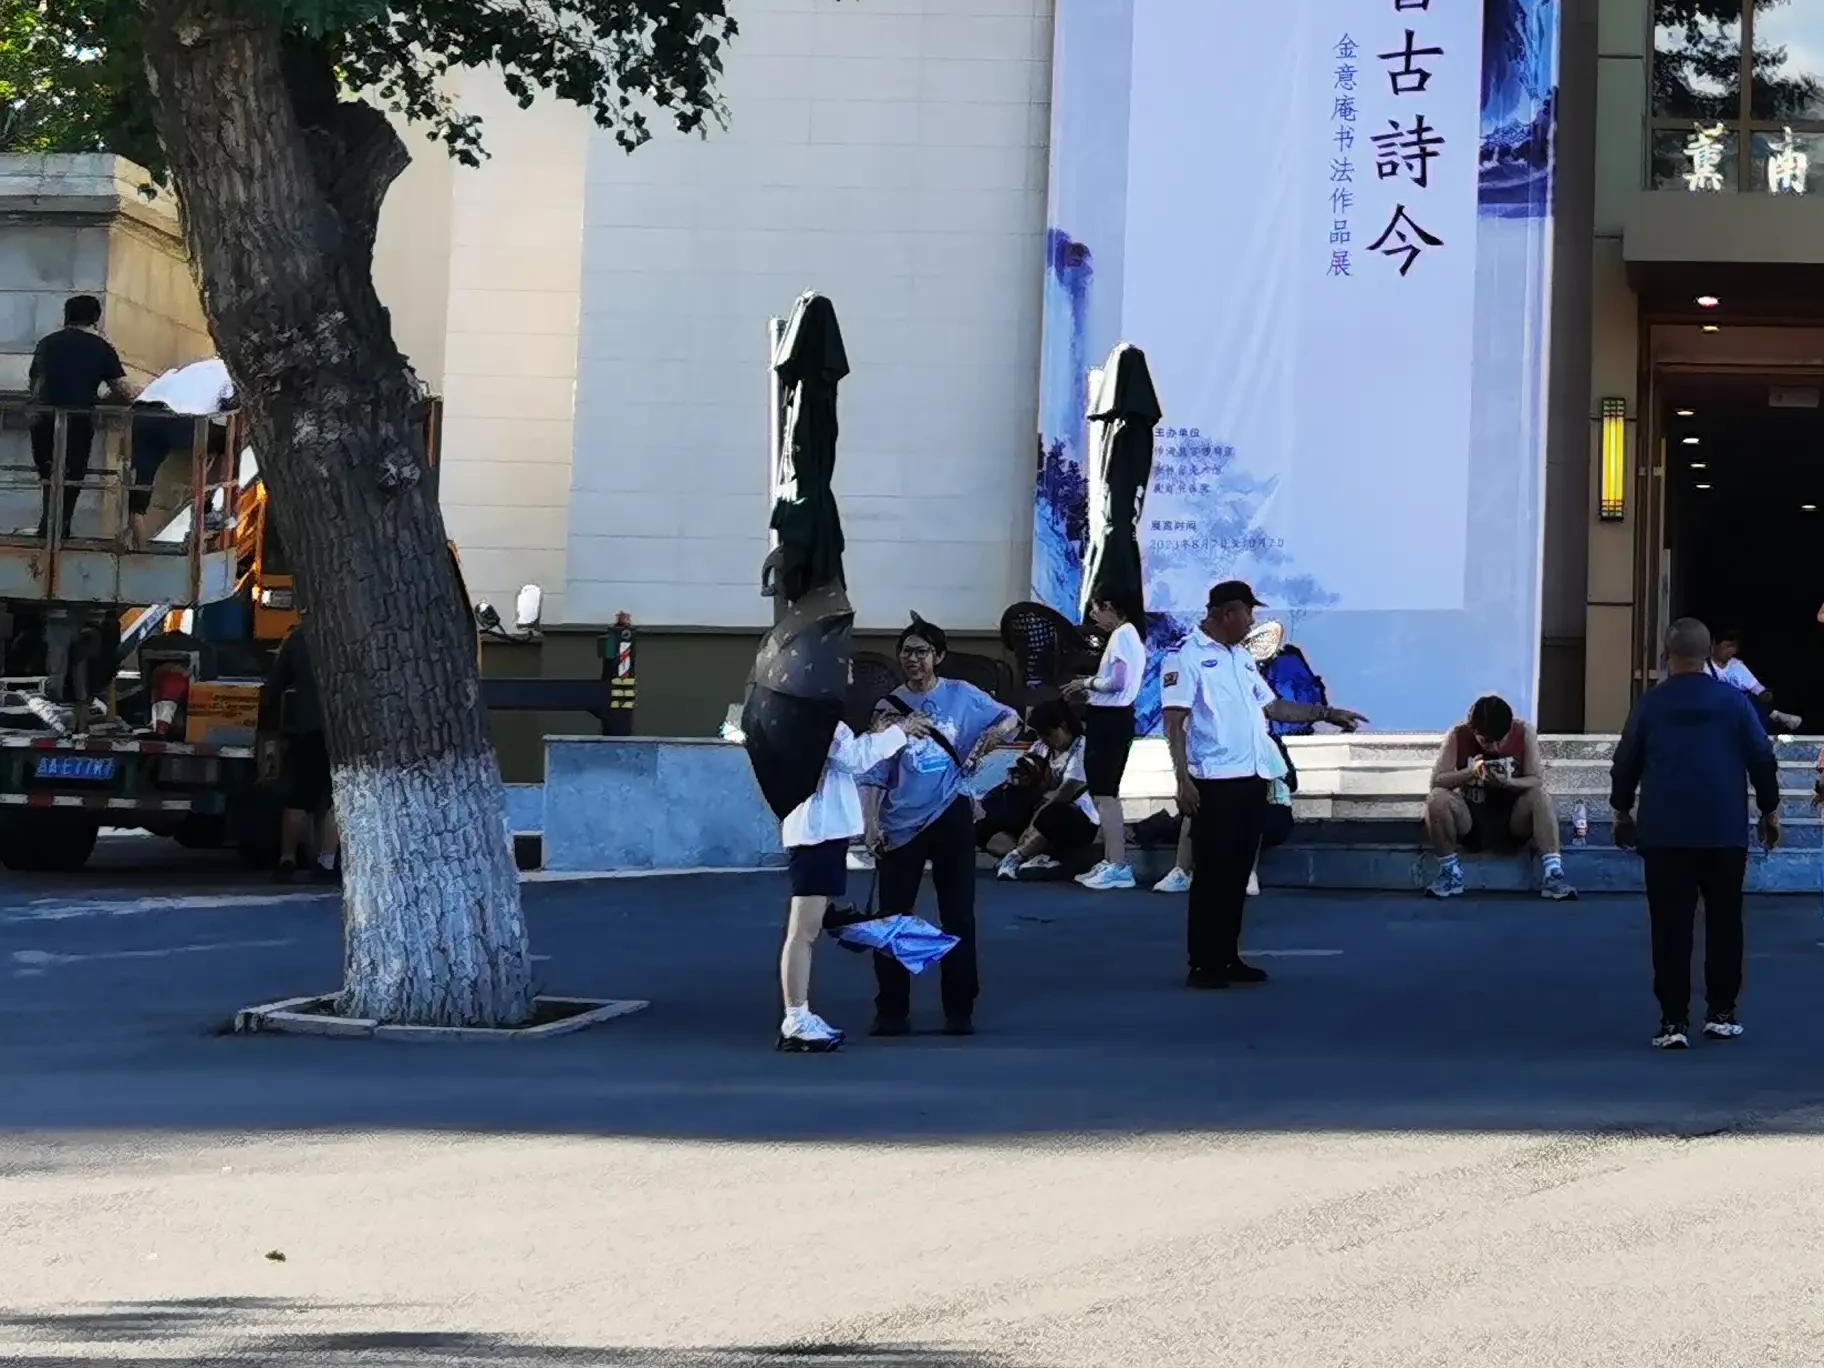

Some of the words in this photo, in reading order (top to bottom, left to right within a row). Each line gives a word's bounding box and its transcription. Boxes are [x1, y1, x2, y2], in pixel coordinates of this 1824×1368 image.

[1326, 32, 1360, 277] 金意庵书法作品展
